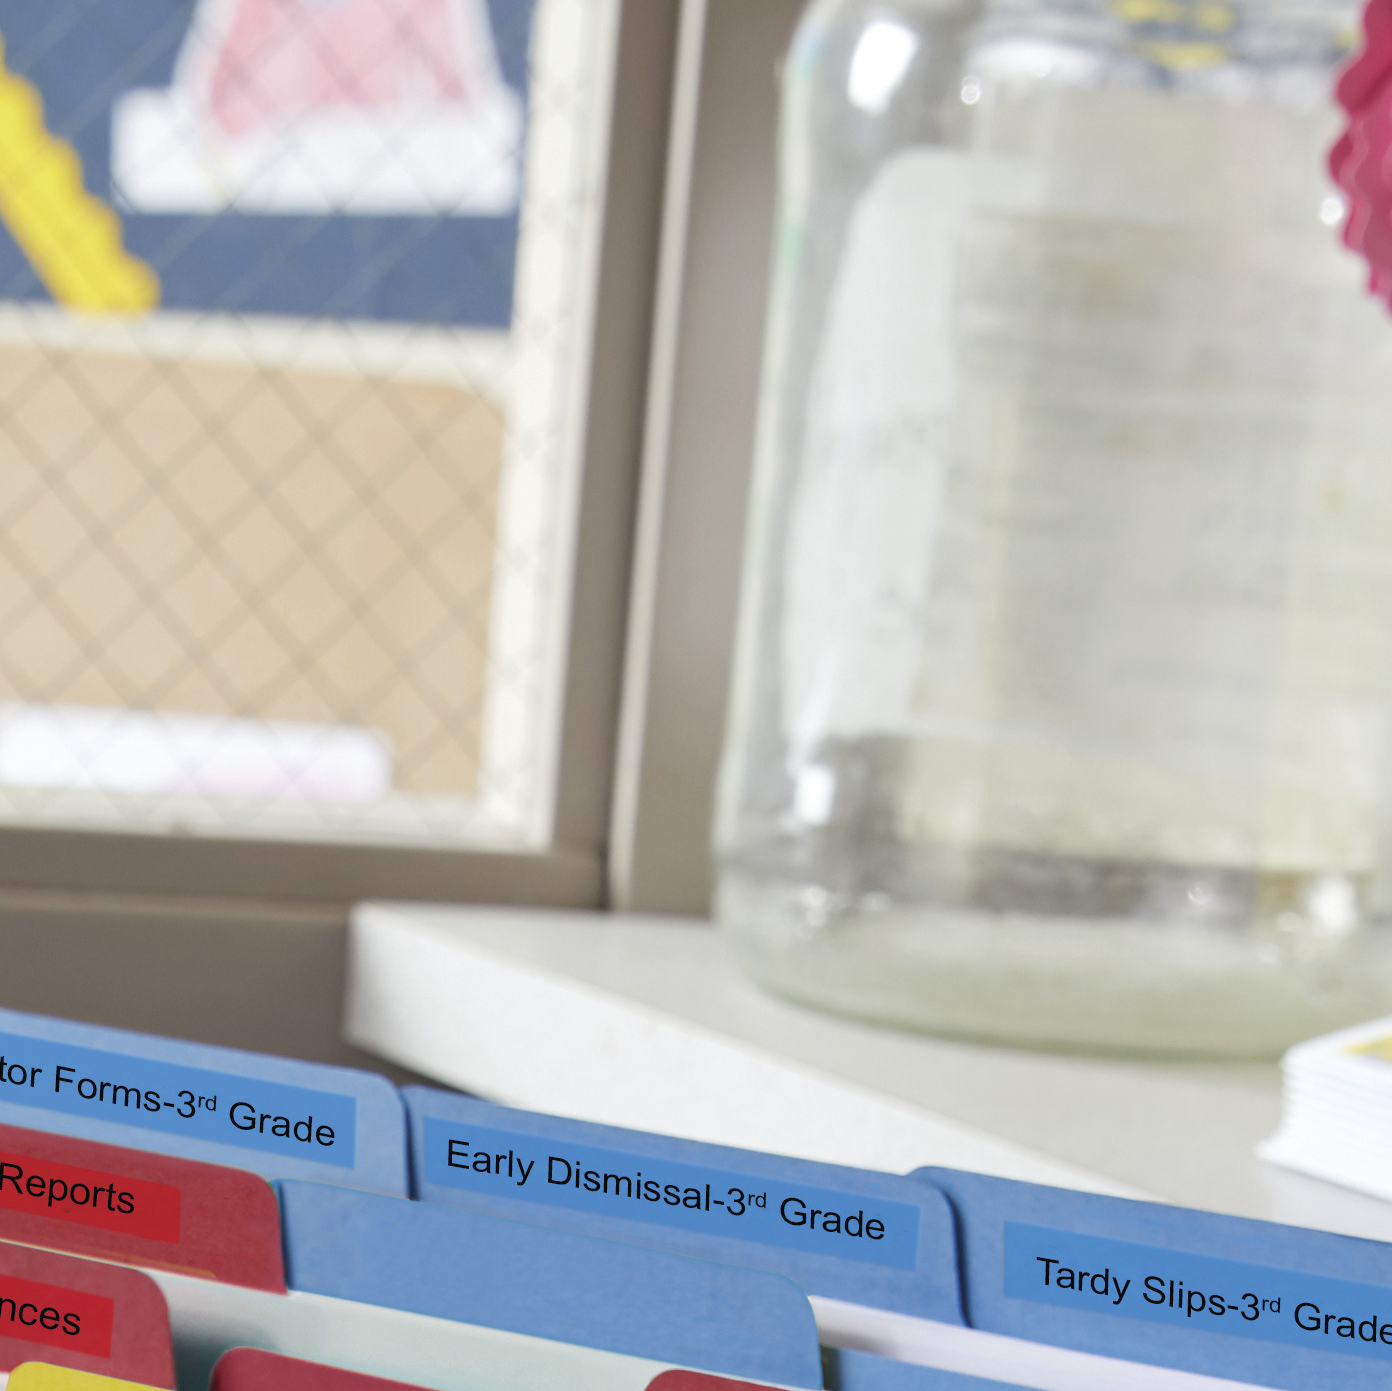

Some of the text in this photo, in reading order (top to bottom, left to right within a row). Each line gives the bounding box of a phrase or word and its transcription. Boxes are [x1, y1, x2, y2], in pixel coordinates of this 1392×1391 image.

[53, 1064, 218, 1120] Forms-3rd
[228, 1100, 336, 1148] Grade
[446, 1137, 886, 1241] Early Dismissal-3rd Grade
[1035, 1255, 1132, 1306] Tardy
[1141, 1274, 1282, 1322] Slips-3rd
